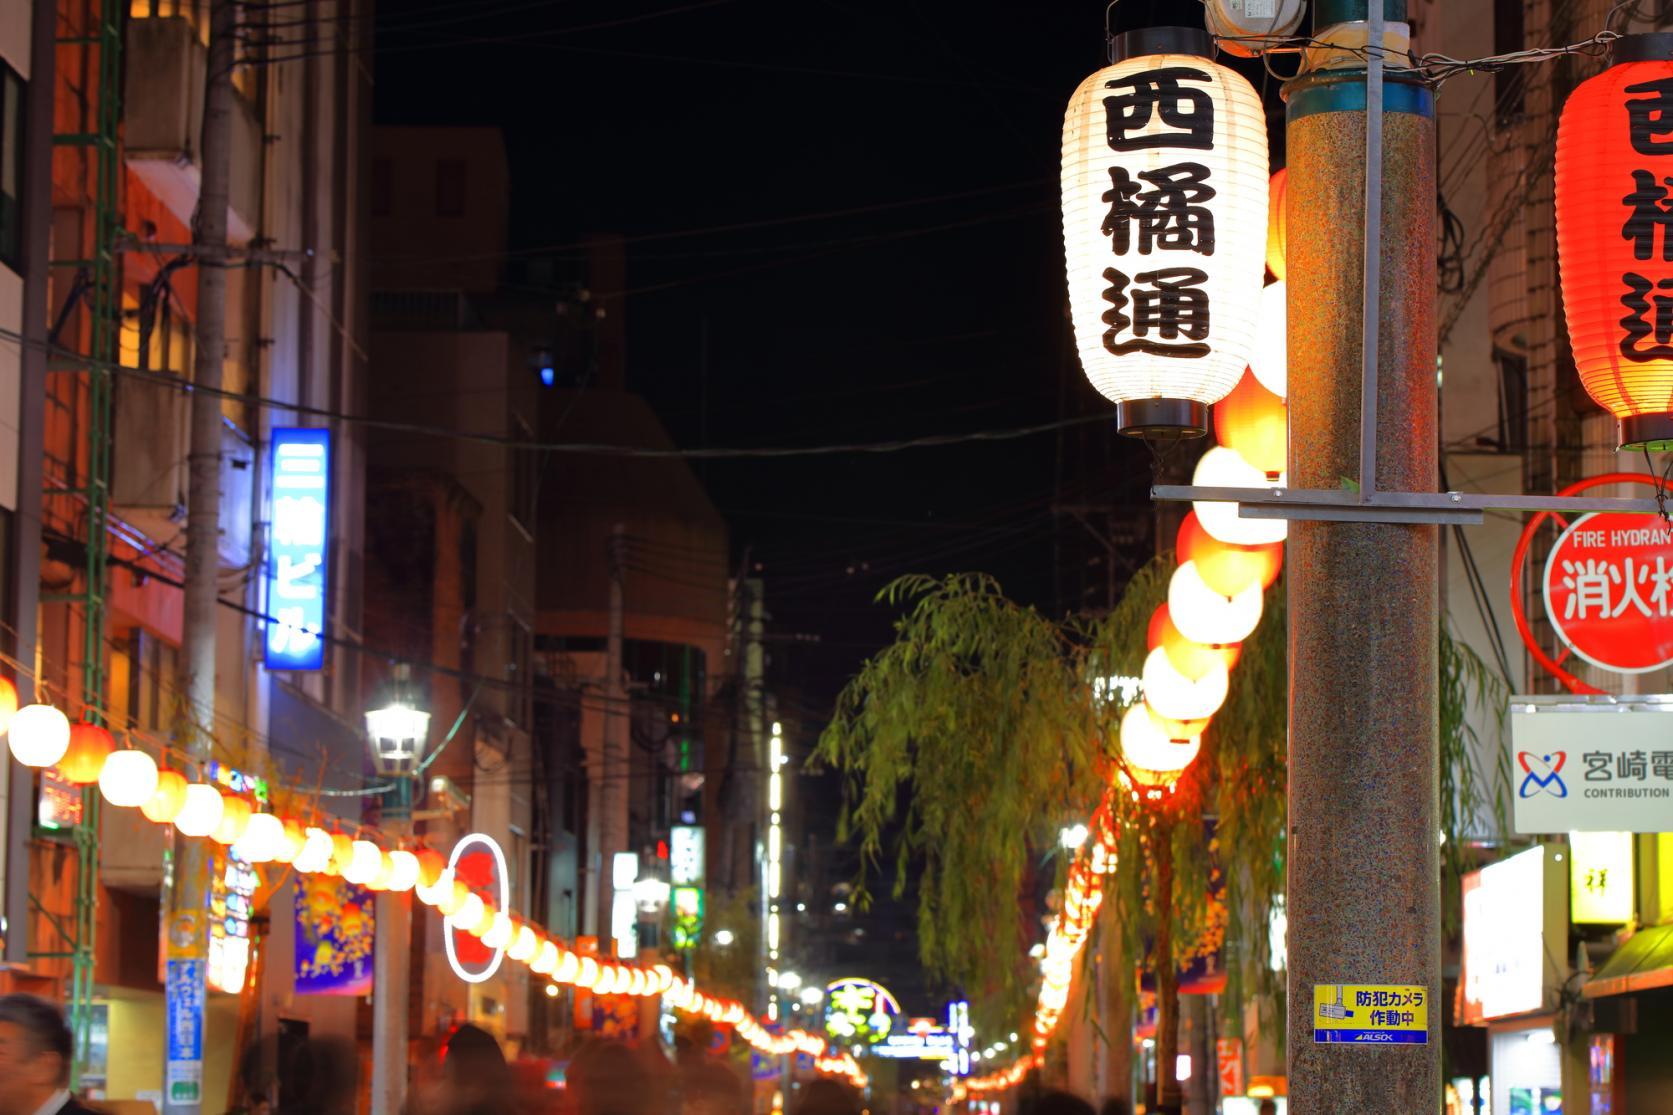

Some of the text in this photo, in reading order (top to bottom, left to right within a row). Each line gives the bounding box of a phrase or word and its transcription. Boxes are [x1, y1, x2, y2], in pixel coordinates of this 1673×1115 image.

[1101, 67, 1216, 359] 西橘通
[1573, 530, 1606, 548] FIRE
[1584, 788, 1670, 798] CONTRIBUTION
[1356, 990, 1424, 1007] 防犯カメラ
[1370, 1009, 1414, 1026] 作動中
[1362, 1033, 1393, 1041] ALSOK
